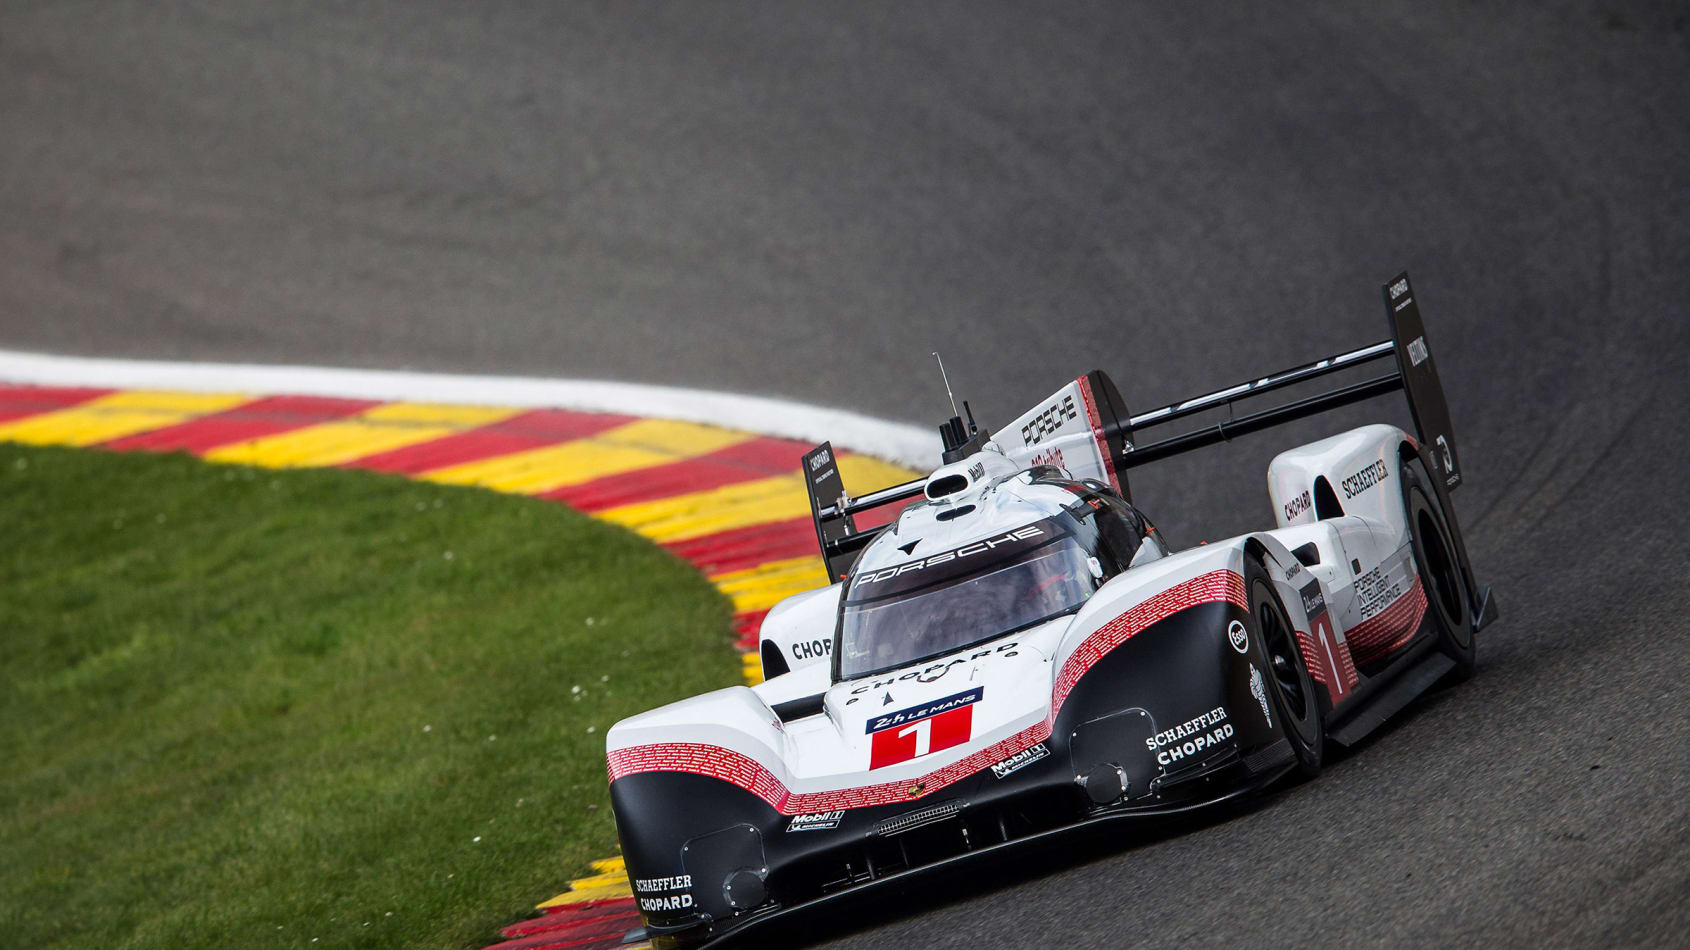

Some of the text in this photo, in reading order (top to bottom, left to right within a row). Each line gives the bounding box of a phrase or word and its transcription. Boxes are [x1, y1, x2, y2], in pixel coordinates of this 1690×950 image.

[1021, 395, 1077, 447] PORSCHE
[1341, 458, 1389, 499] SCHAEFFLER
[1284, 490, 1311, 521] CHOPARD
[853, 525, 1045, 588] PORSCHE
[1353, 566, 1381, 593] PORSCHE
[1356, 575, 1391, 605] INTELLIGENT
[1360, 584, 1402, 621] PERFORMANCE
[1231, 629, 1247, 646] Esso
[850, 642, 1019, 695] CHOPARD
[1318, 622, 1344, 695] 1
[907, 708, 924, 720] LE
[929, 694, 977, 714] MANS
[897, 718, 933, 759] 1
[1145, 706, 1228, 751] SCHAEFFLER
[1157, 723, 1234, 765] CHOPARD
[990, 749, 1032, 773] Mobil
[791, 812, 832, 823] Mobil
[635, 874, 693, 892] SCHAEFFLER
[640, 894, 693, 912] CHOPARD
